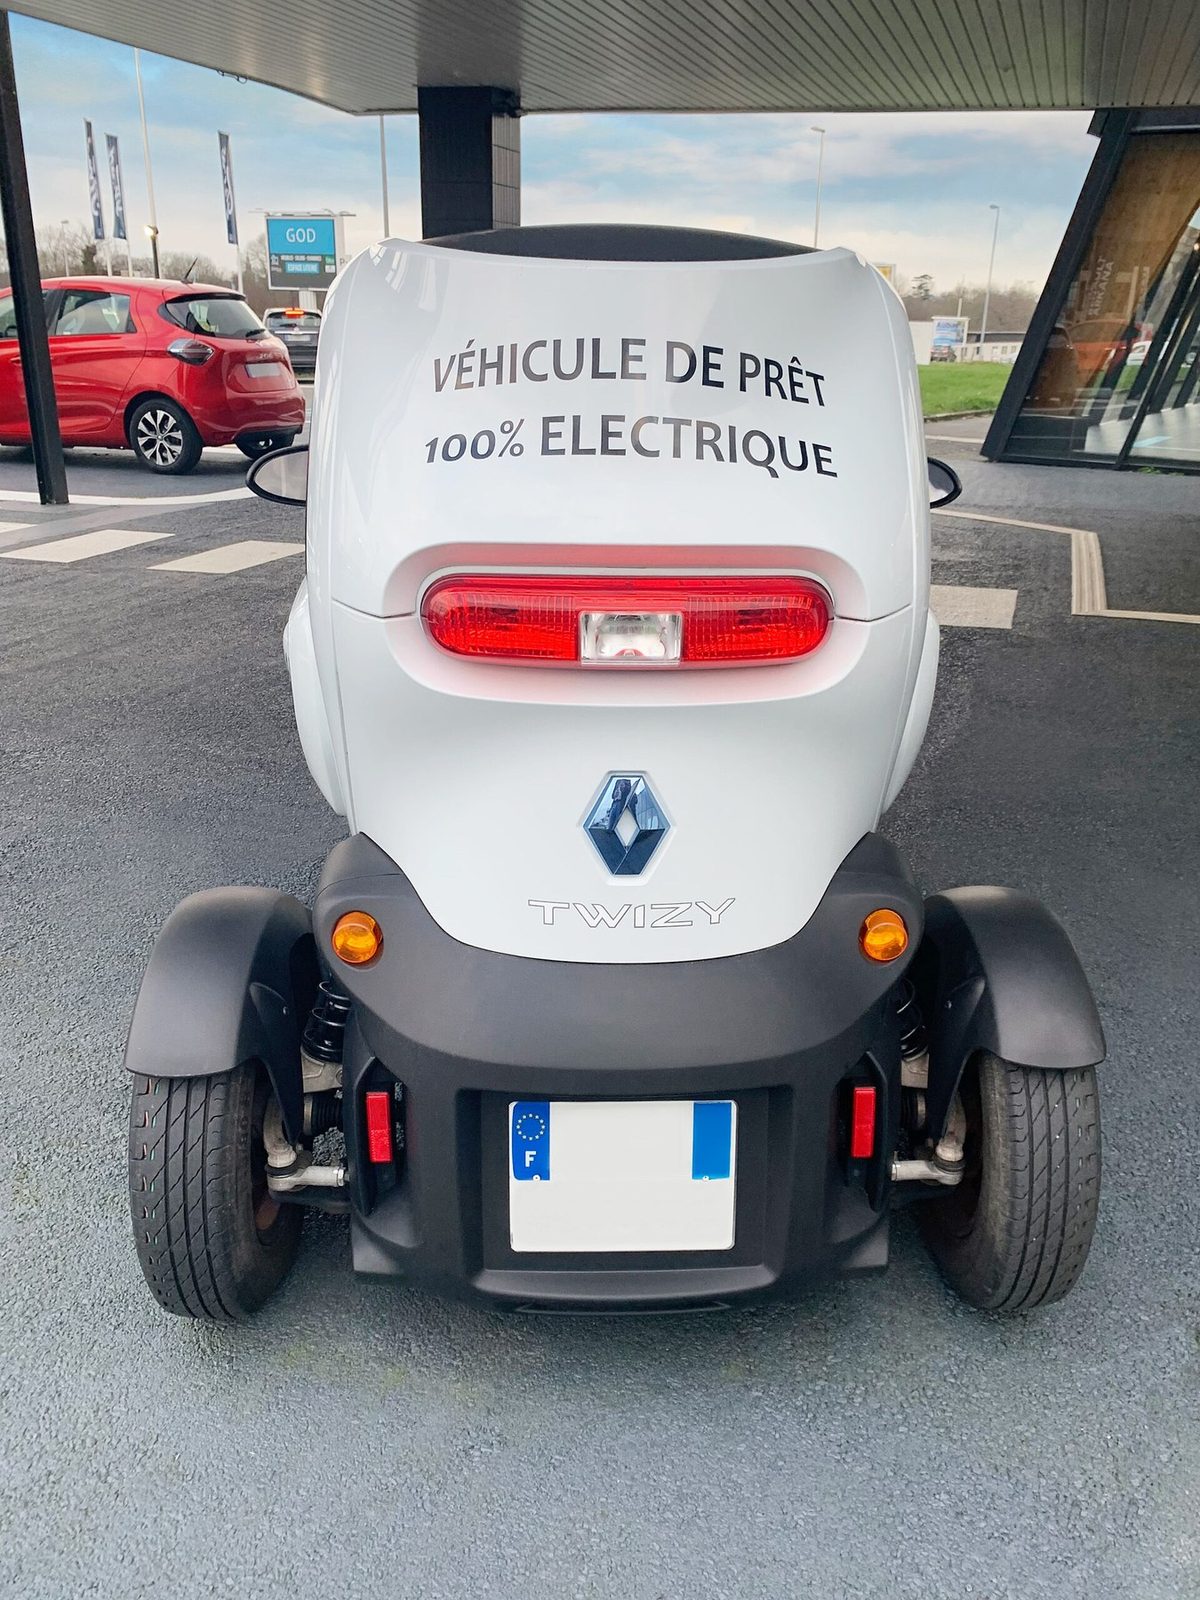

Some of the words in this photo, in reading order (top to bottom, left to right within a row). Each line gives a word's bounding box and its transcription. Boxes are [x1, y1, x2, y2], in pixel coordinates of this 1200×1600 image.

[285, 227, 316, 243] GOD
[434, 338, 647, 393] VÉHICULE
[665, 340, 724, 389] DE
[739, 352, 825, 407] PRÊT
[425, 418, 525, 464] 100%
[541, 414, 838, 479] ELECTRIQUE
[527, 897, 736, 929] TWIZY
[524, 1150, 537, 1168] F
